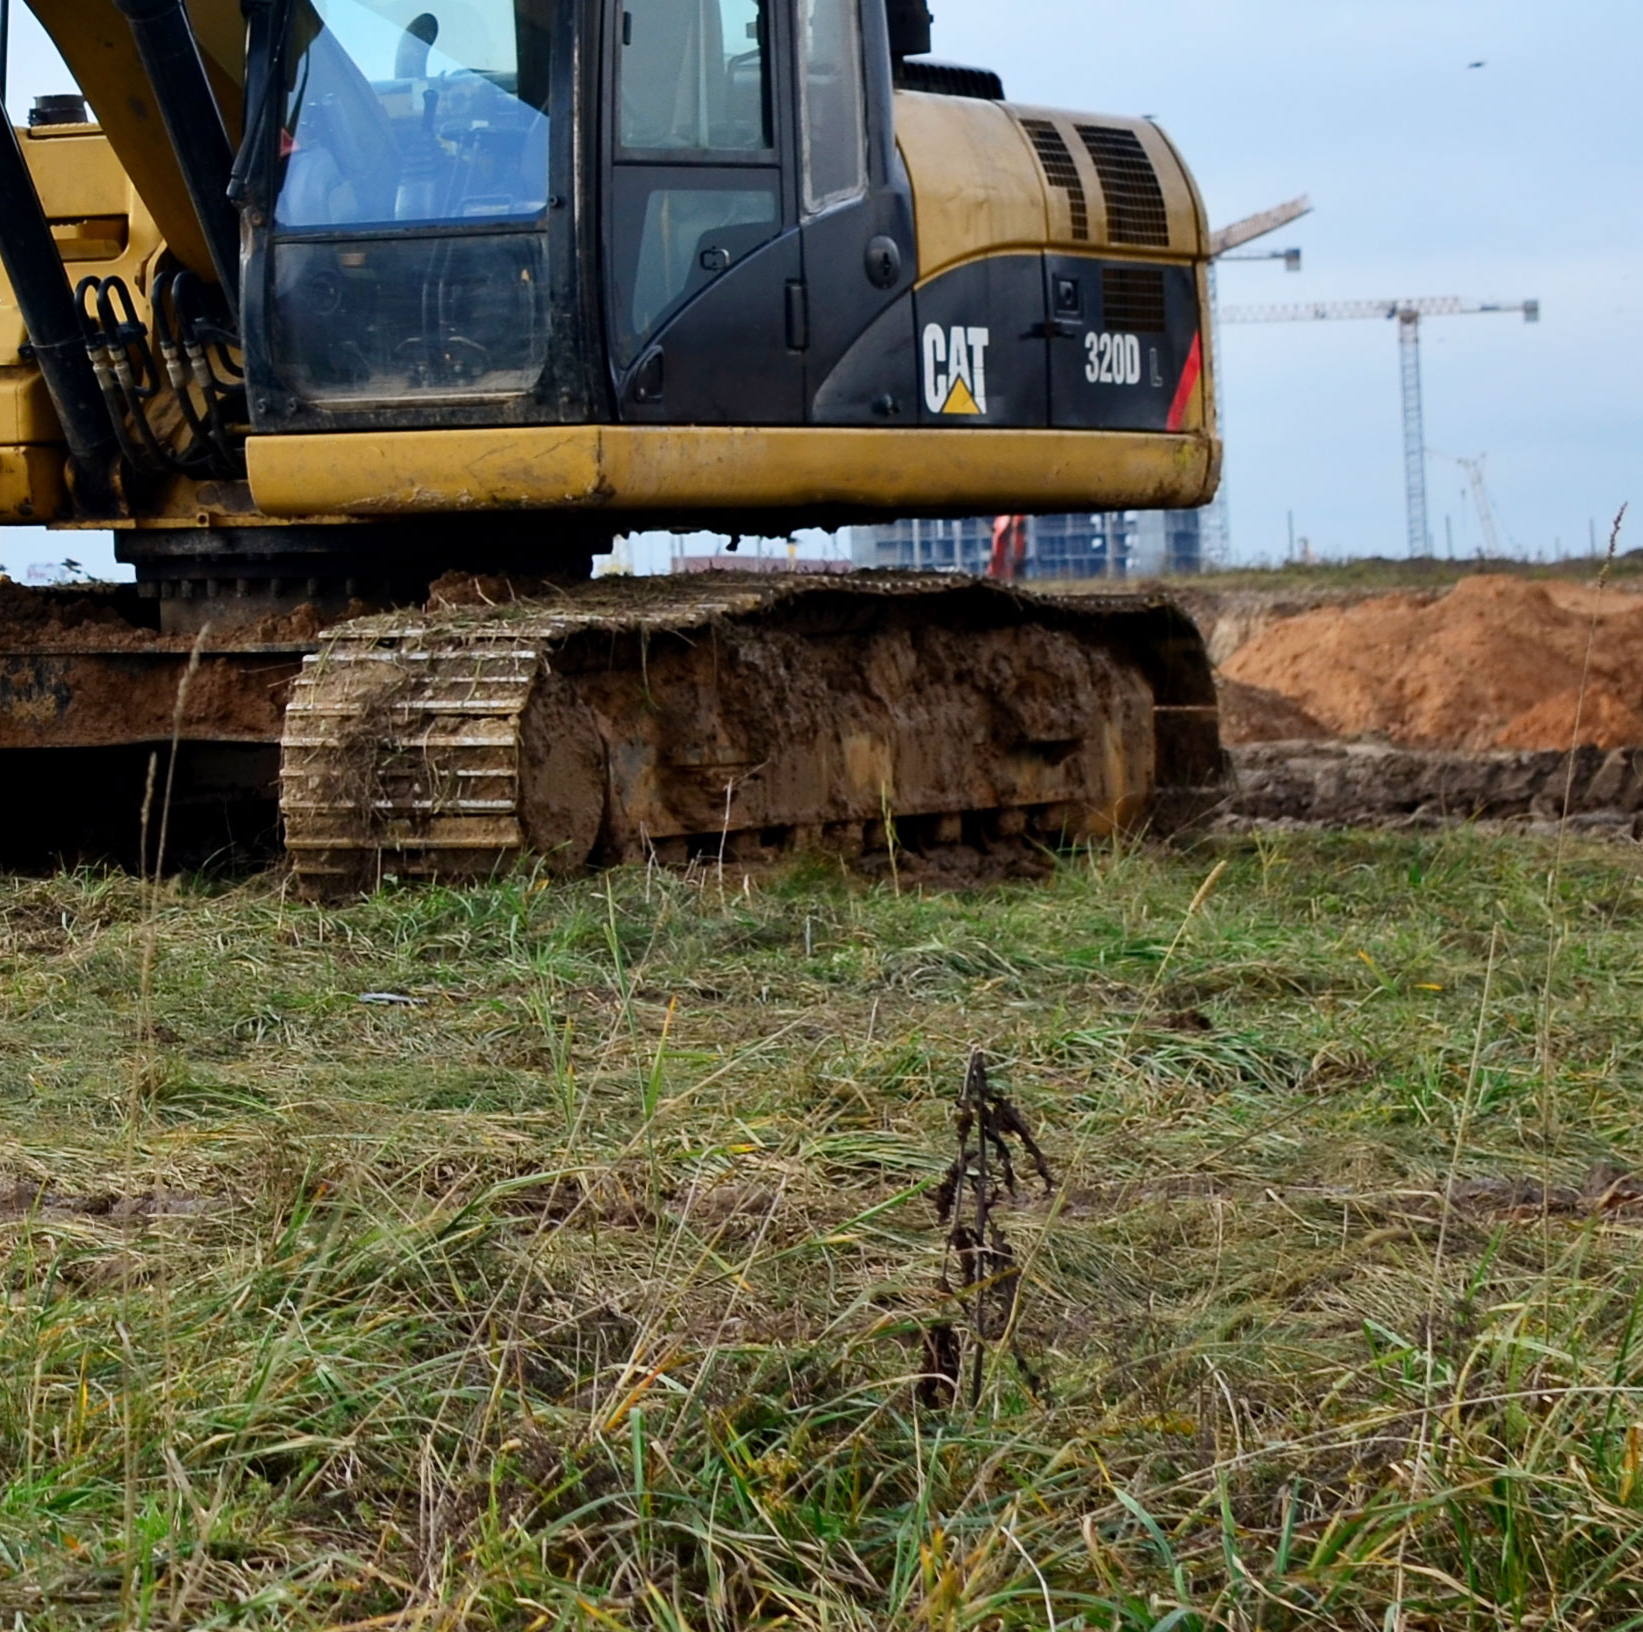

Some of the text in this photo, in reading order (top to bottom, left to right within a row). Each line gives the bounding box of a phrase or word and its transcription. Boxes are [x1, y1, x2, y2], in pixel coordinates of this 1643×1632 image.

[922, 322, 989, 415] CAT
[1084, 331, 1163, 387] 320D L
